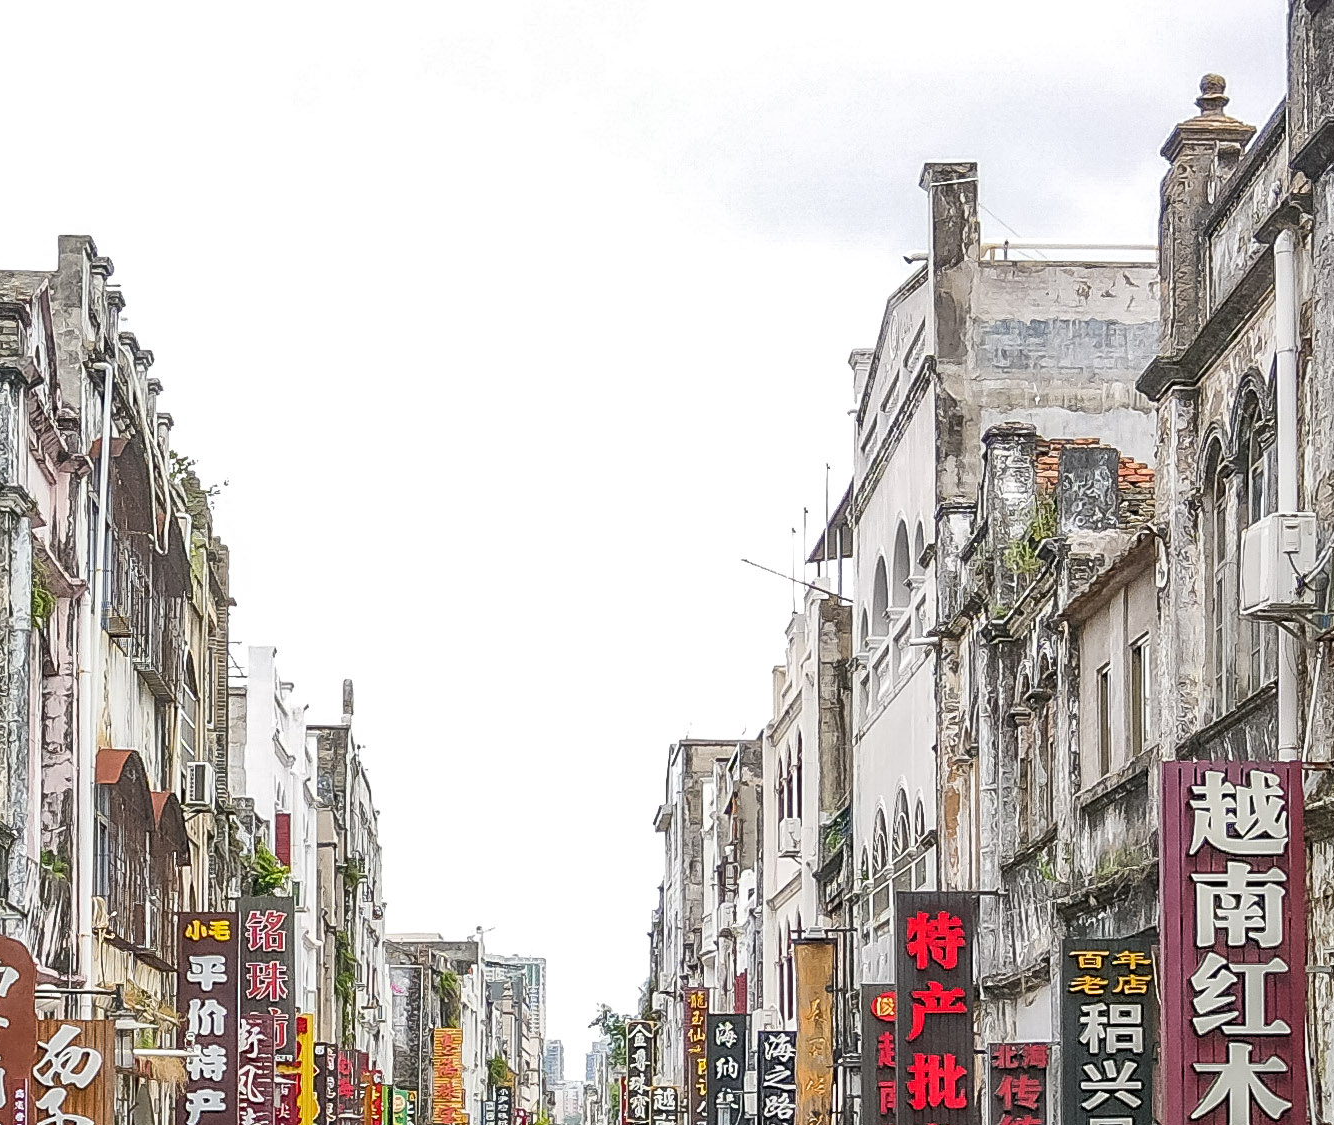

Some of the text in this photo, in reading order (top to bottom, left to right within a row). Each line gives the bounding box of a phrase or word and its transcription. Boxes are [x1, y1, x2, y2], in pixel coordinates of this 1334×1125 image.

[185, 920, 230, 941] 小毛
[1069, 951, 1151, 969] 百年
[1069, 975, 1150, 995] 老店
[993, 1045, 1048, 1069] 北海
